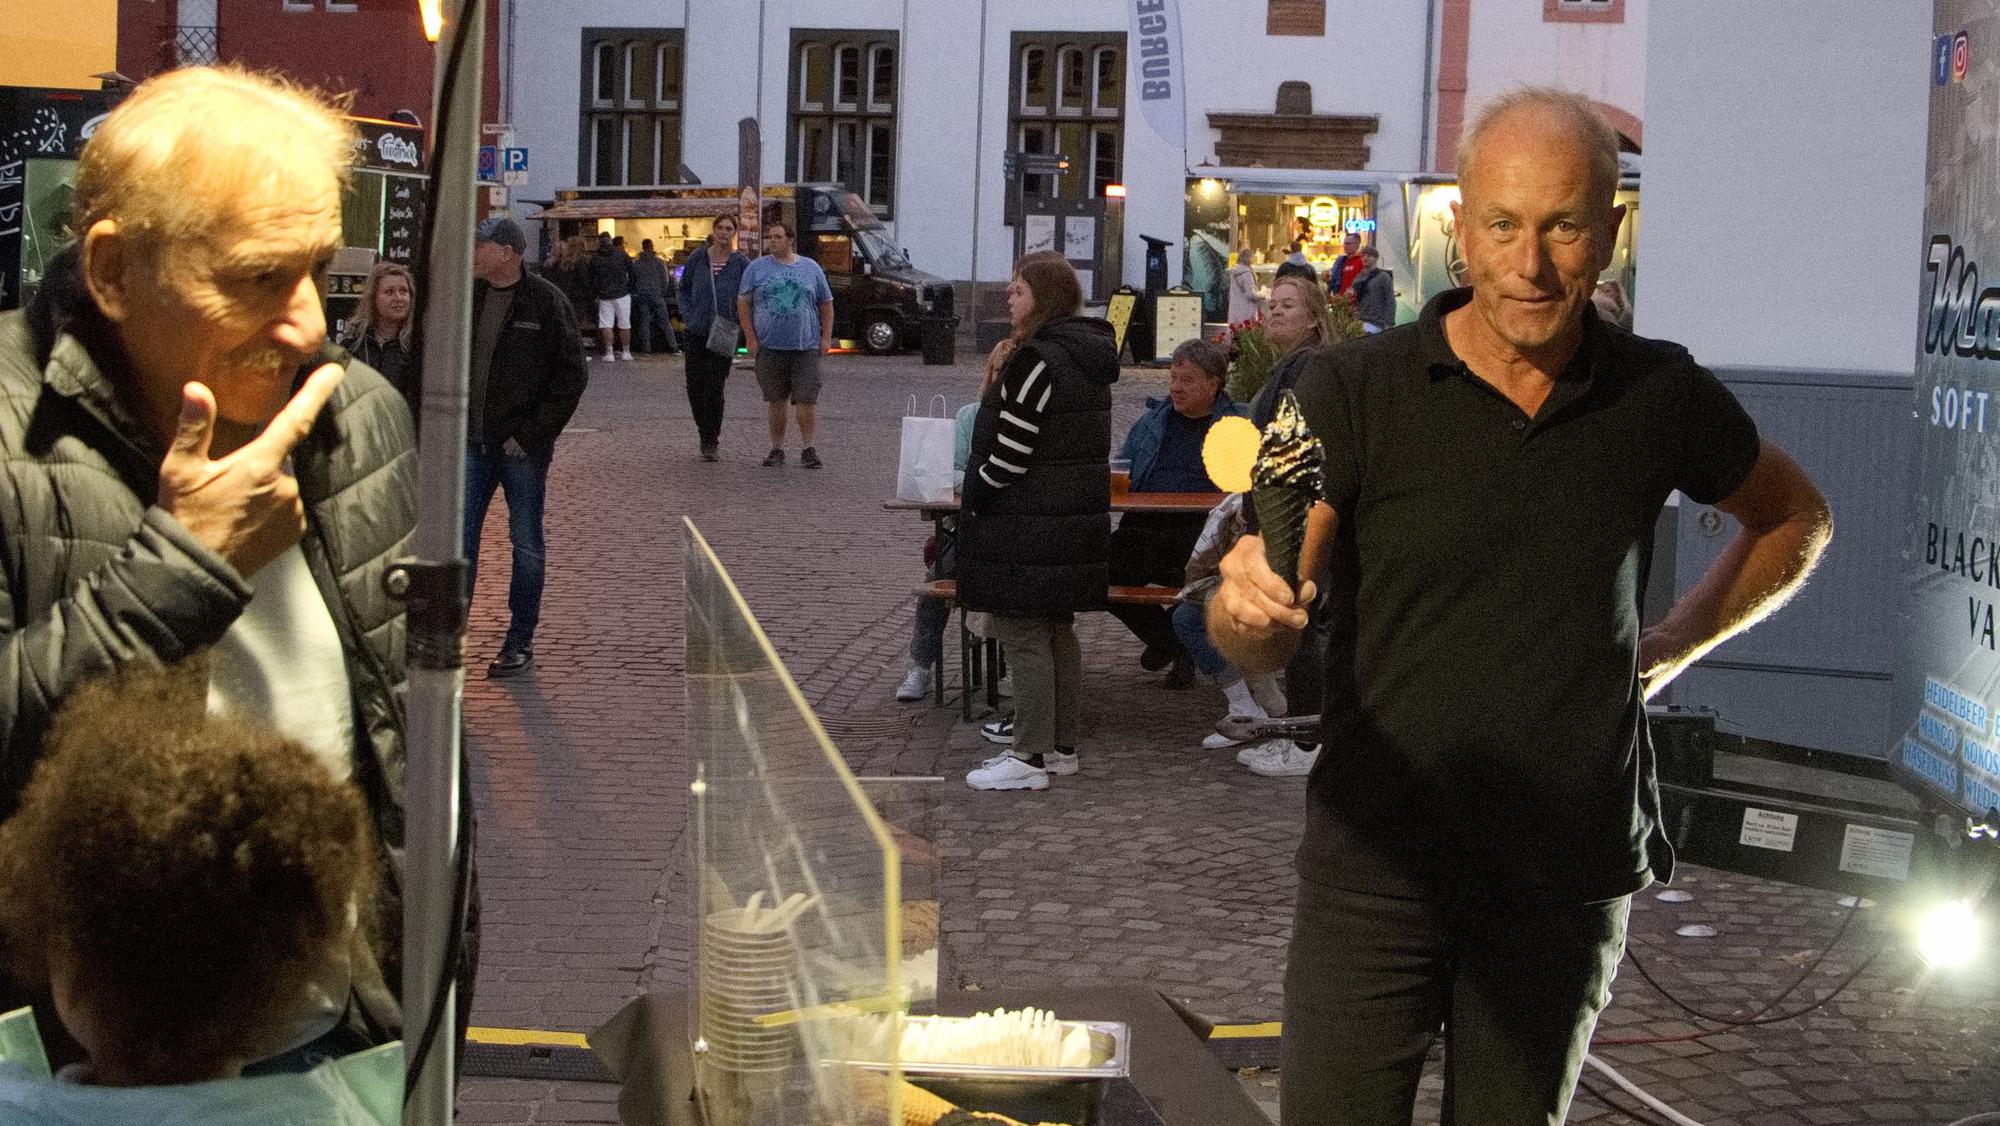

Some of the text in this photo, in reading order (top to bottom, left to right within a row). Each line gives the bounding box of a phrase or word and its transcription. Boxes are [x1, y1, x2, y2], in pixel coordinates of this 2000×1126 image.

[1137, 0, 1171, 100] BURGE
[510, 150, 524, 169] P
[1345, 219, 1376, 234] open
[1931, 386, 1988, 433] SOFT
[1926, 522, 2000, 590] BLACK
[1969, 596, 1996, 651] VA
[1925, 679, 1985, 730] HEIDELBEER
[1919, 711, 1999, 776] MANGO KOKOS
